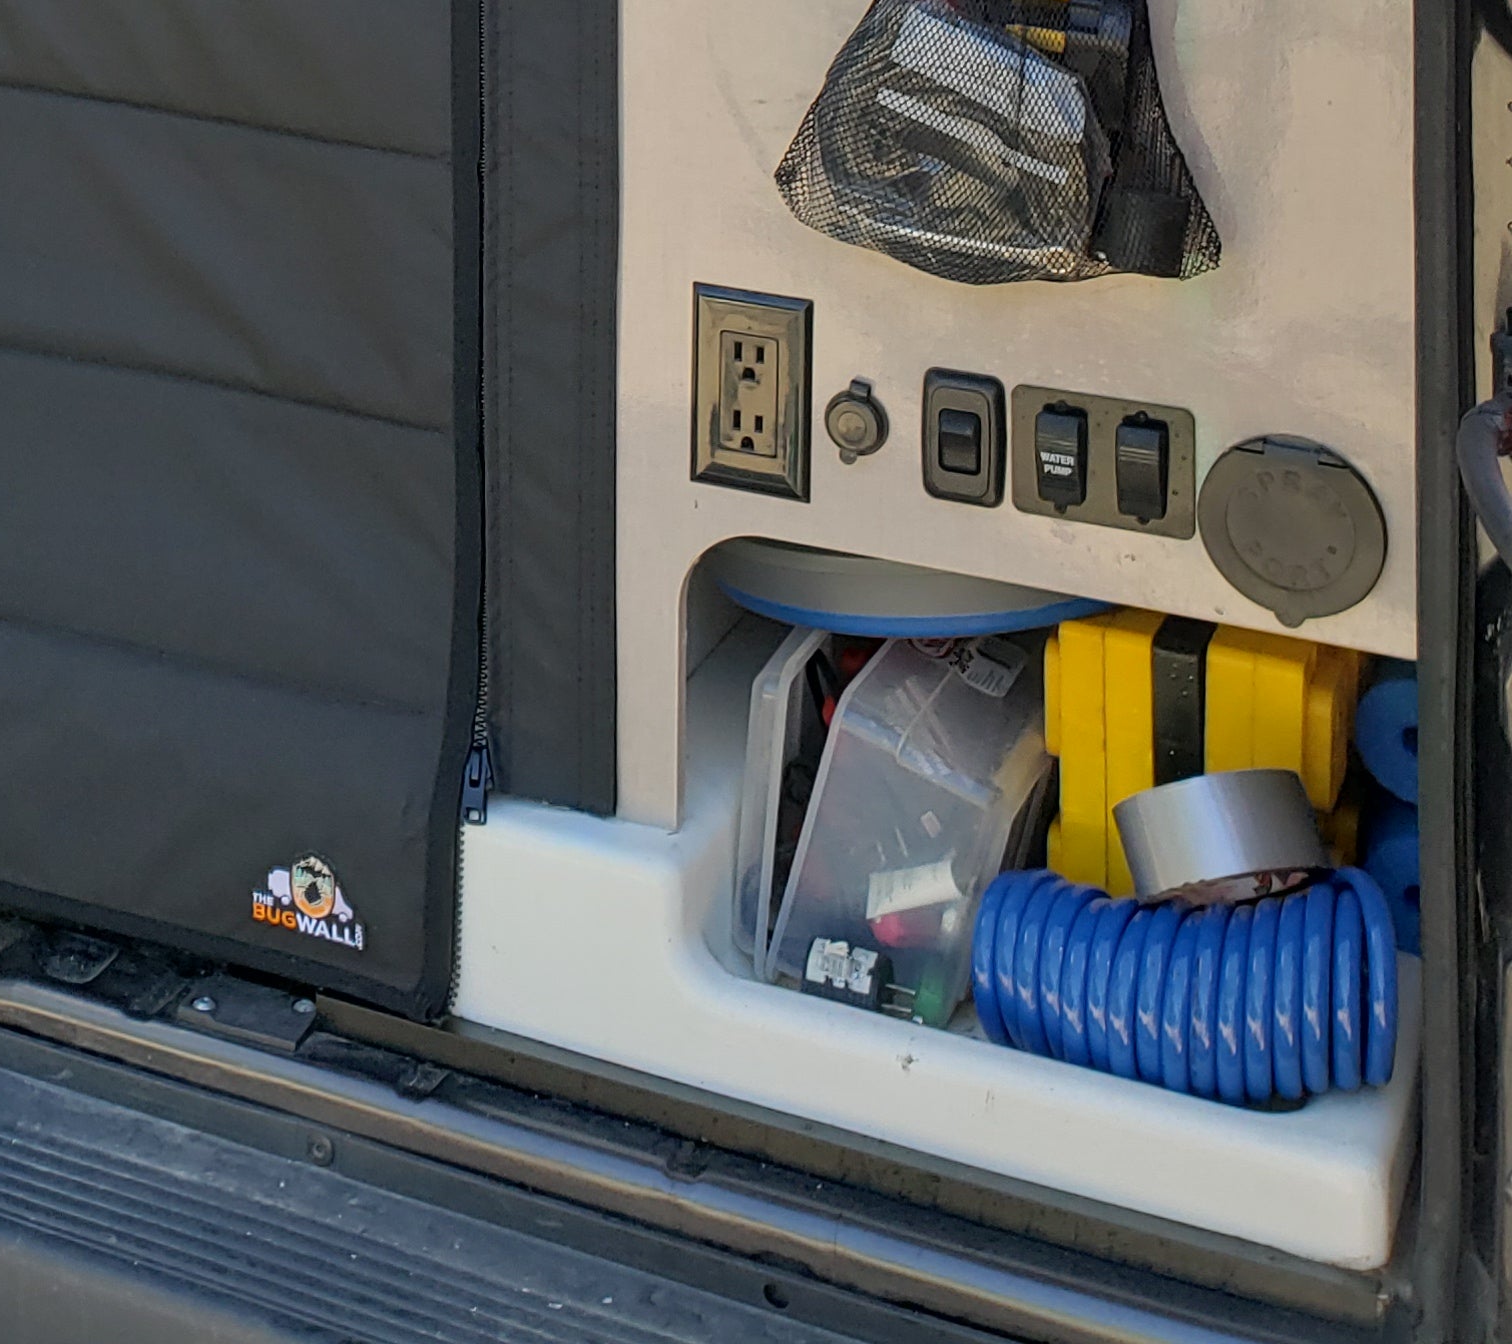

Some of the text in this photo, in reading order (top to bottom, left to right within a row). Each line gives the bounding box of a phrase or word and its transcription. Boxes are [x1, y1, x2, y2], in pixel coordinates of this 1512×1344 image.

[1040, 451, 1075, 467] WATER
[1043, 463, 1073, 476] PUMP
[251, 891, 275, 907] THE
